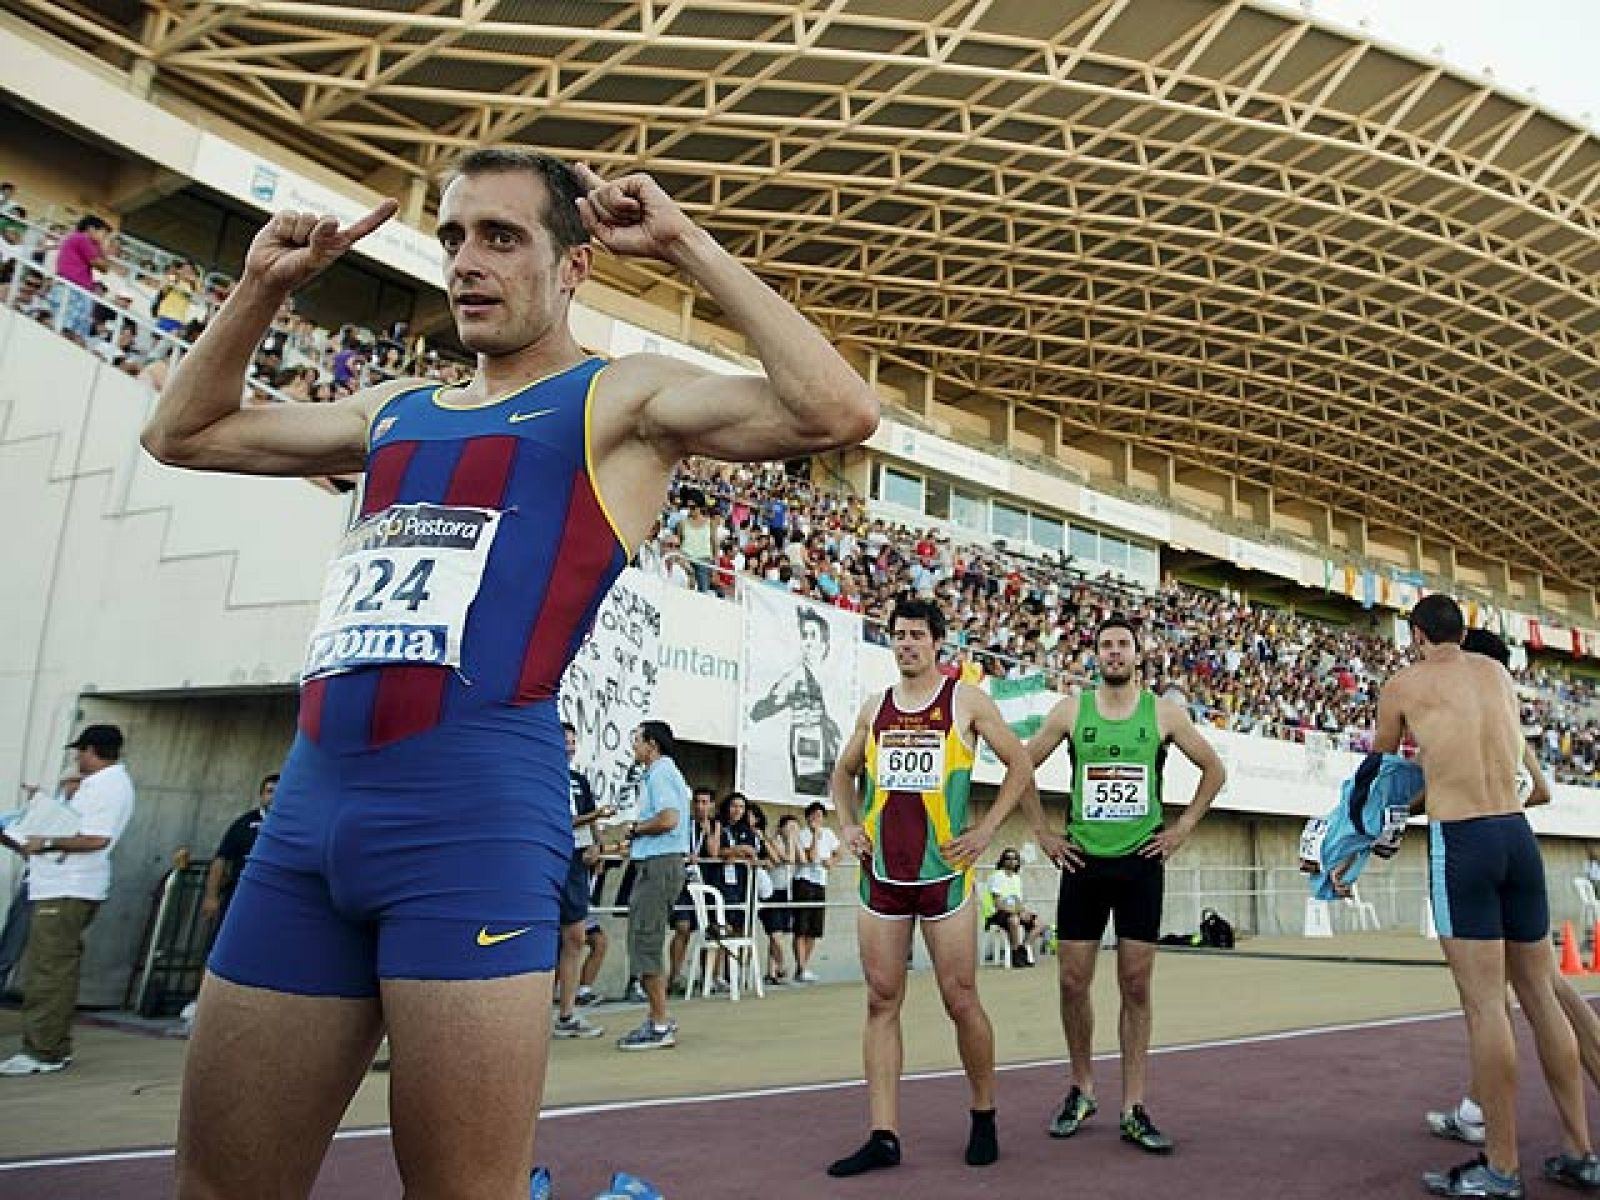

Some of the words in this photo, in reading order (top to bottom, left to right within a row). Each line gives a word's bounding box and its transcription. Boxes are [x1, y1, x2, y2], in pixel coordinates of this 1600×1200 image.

[404, 517, 478, 539] Pastora
[889, 750, 933, 773] 600
[1095, 782, 1138, 803] 552
